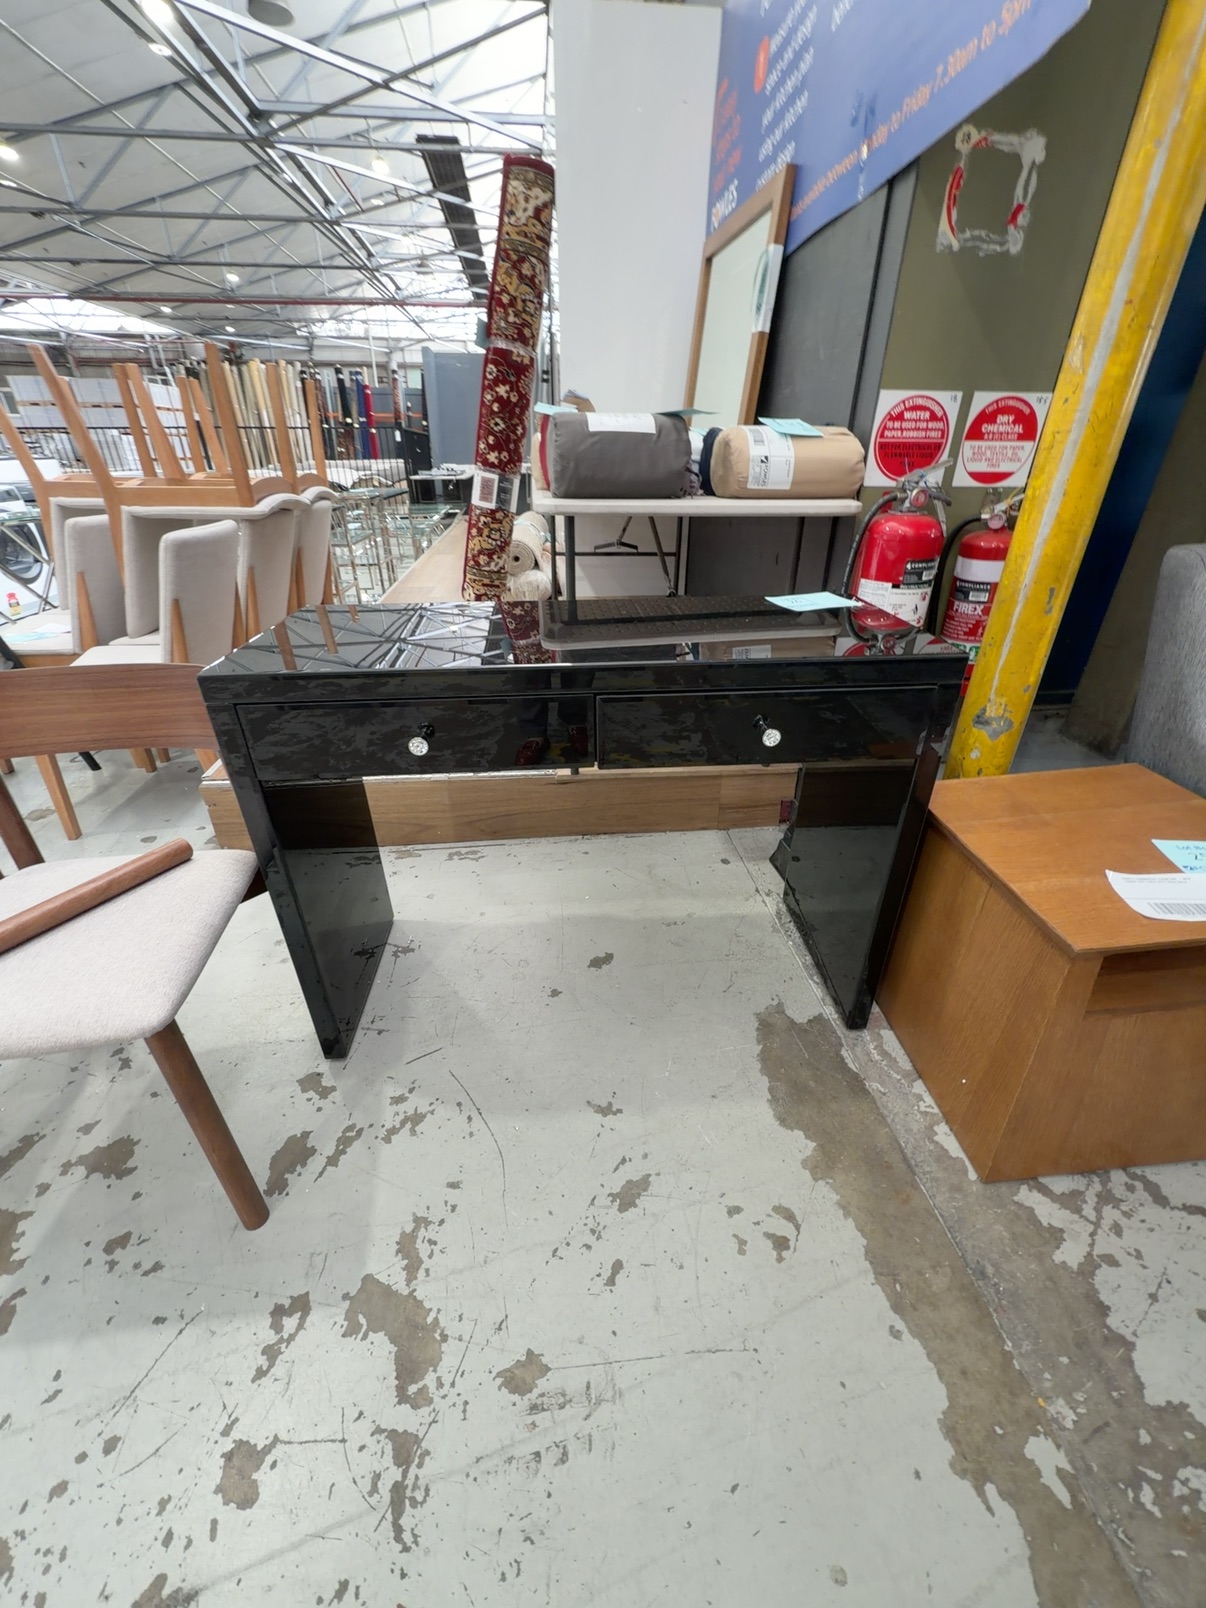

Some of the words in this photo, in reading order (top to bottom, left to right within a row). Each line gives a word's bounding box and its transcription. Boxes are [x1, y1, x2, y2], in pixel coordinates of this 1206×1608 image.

[981, 20, 996, 50] to
[890, 402, 905, 417] THIS
[904, 410, 930, 419] WATER
[997, 414, 1015, 424] DRY
[894, 421, 900, 429] BE
[902, 421, 915, 429] USED
[916, 421, 927, 429] FOR
[982, 423, 1024, 433] CHEMICAL
[926, 430, 942, 438] FIRES
[953, 601, 985, 615] FIREX
